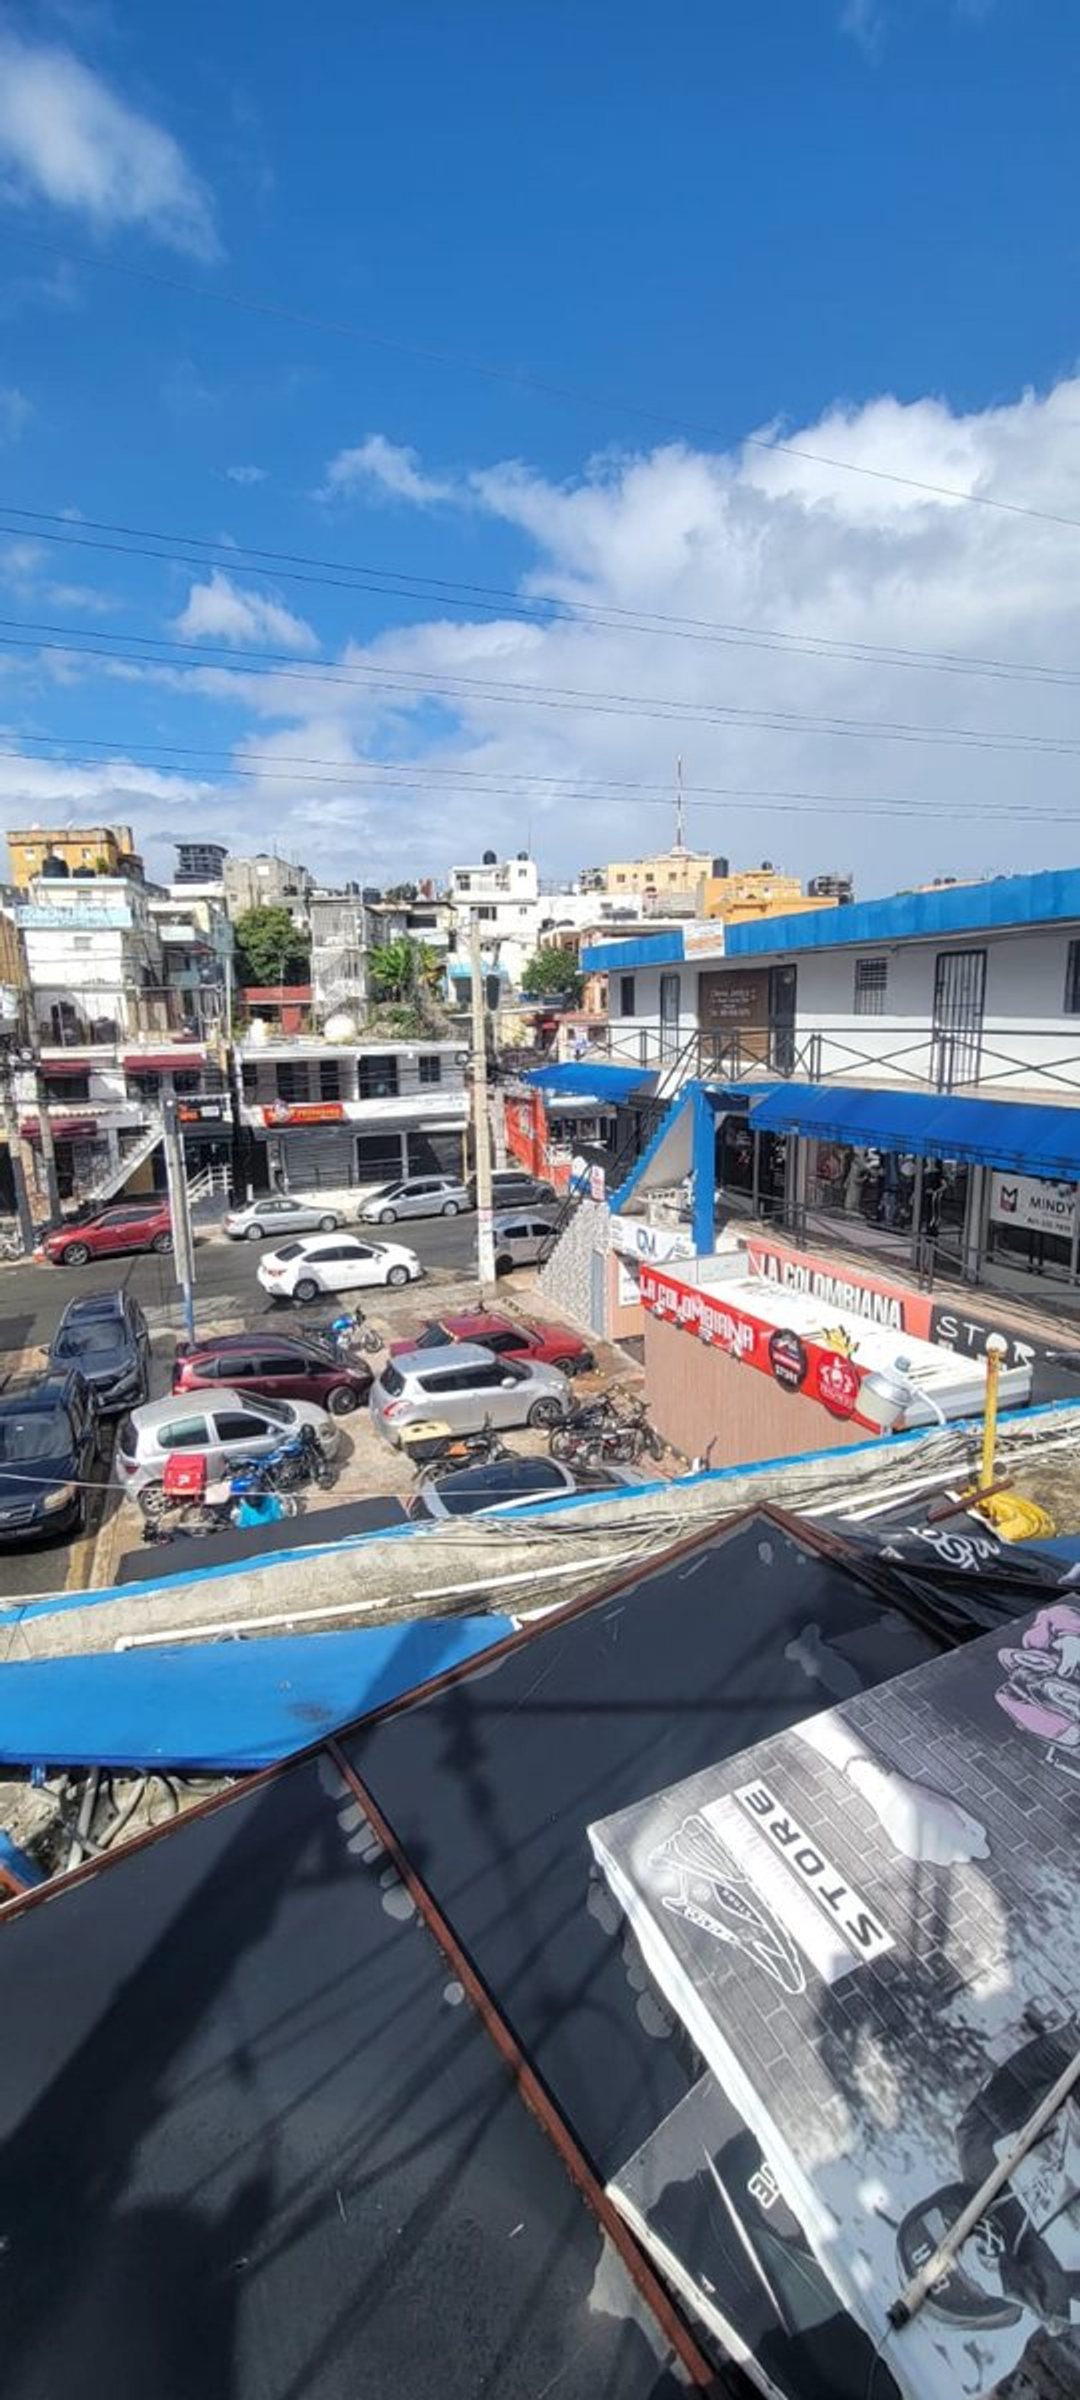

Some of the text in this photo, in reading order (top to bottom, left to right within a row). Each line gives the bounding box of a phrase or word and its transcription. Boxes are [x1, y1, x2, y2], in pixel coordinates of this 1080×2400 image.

[1030, 1196, 1076, 1215] MINDY
[640, 1273, 657, 1303] LA
[658, 1283, 754, 1353] COLOMBIANA
[760, 1252, 904, 1331] LA COLOMBIANA
[745, 1786, 884, 1948] STORE
